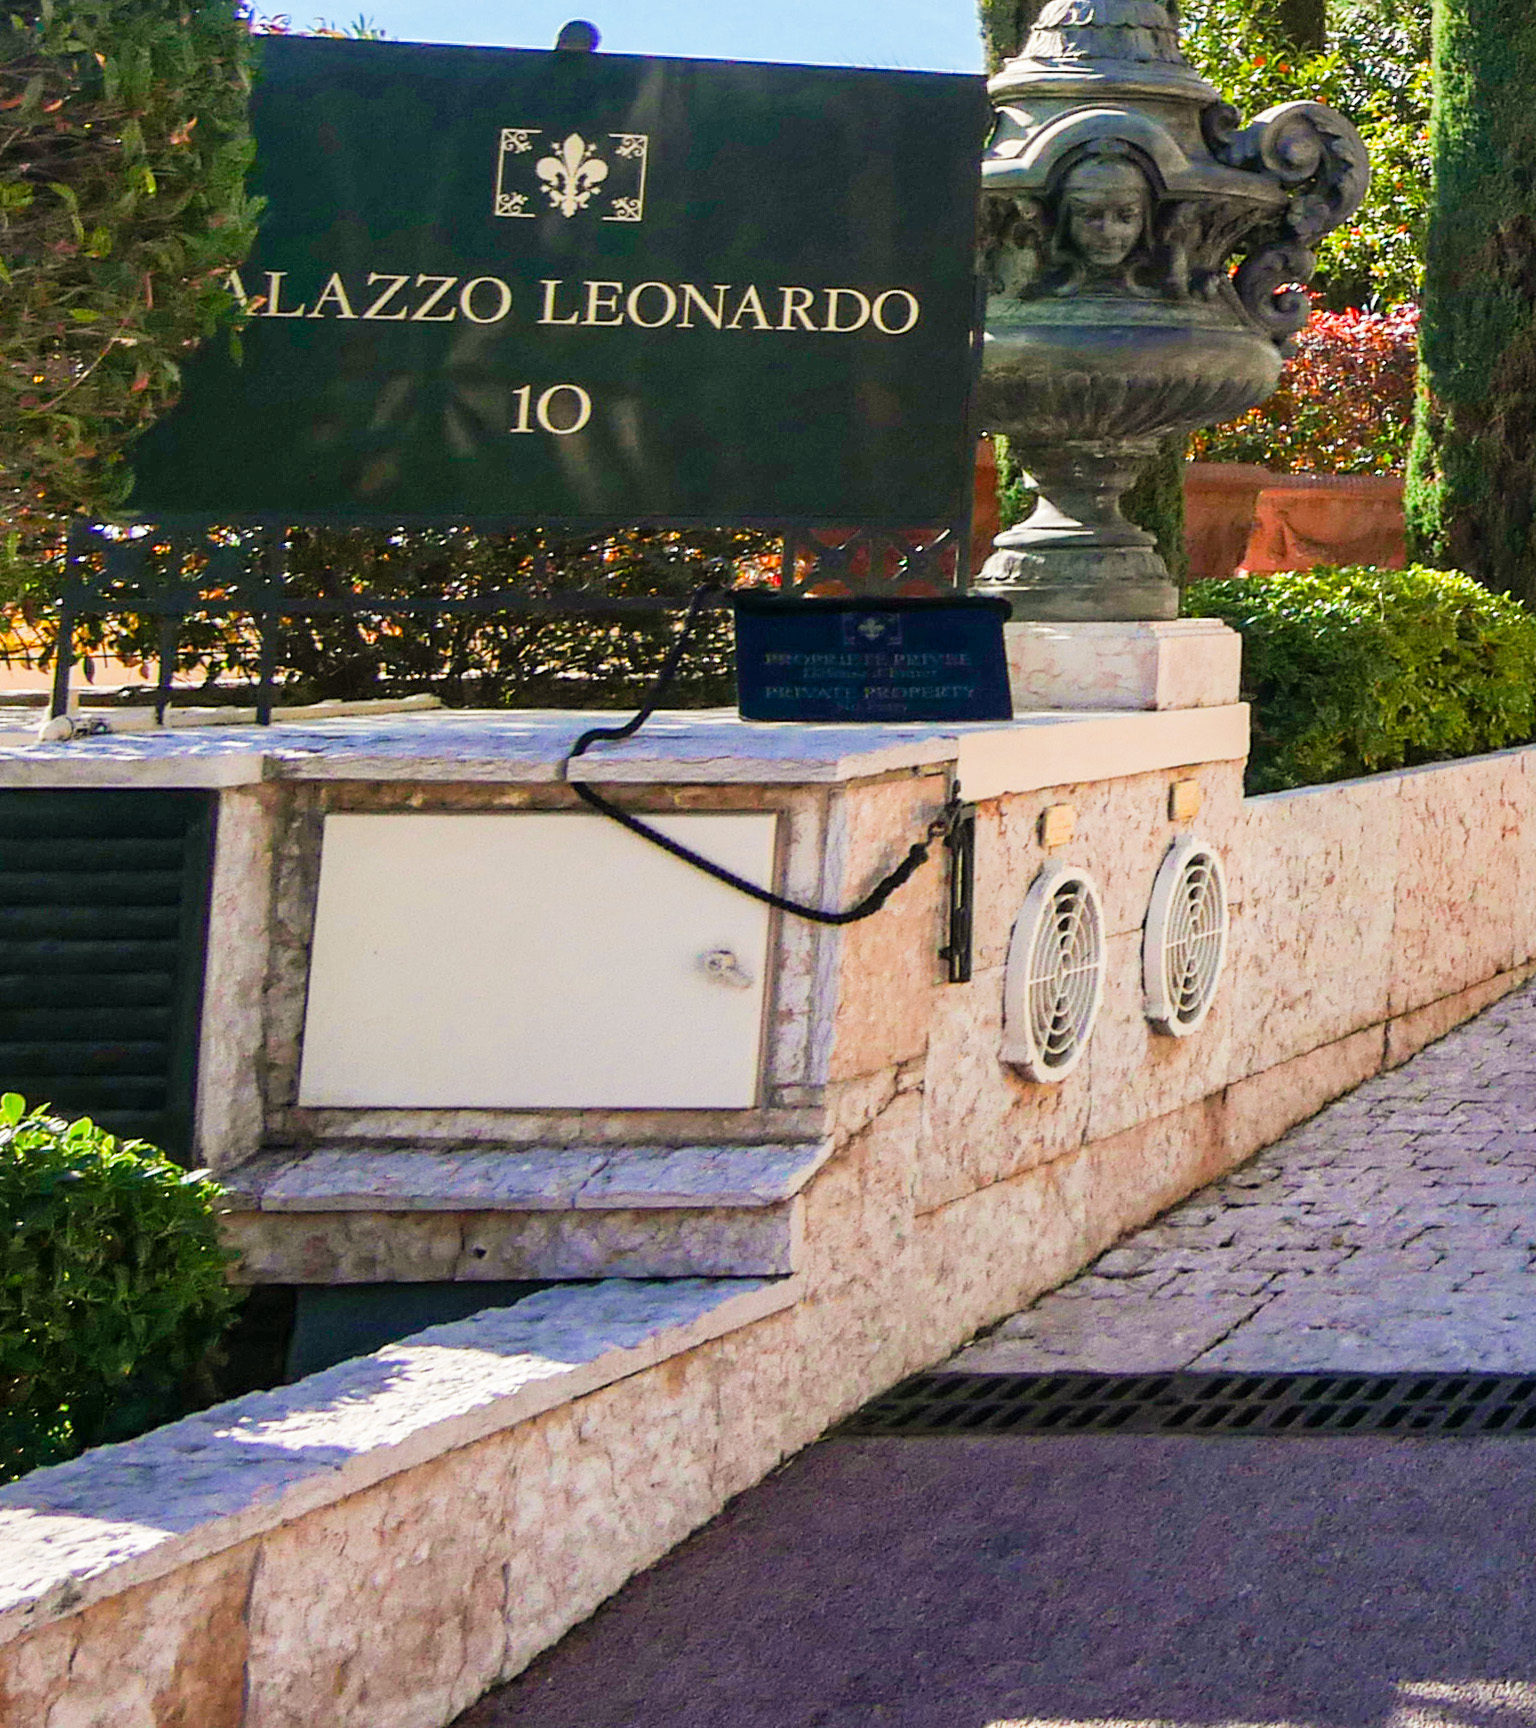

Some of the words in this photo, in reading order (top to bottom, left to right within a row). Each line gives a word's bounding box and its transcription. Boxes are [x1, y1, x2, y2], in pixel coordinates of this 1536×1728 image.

[224, 269, 512, 324] ALAZZO
[536, 279, 919, 335] LEONARDO
[509, 384, 592, 435] 10
[764, 685, 852, 700] PRIVATE
[863, 685, 975, 700] PROPERTY
